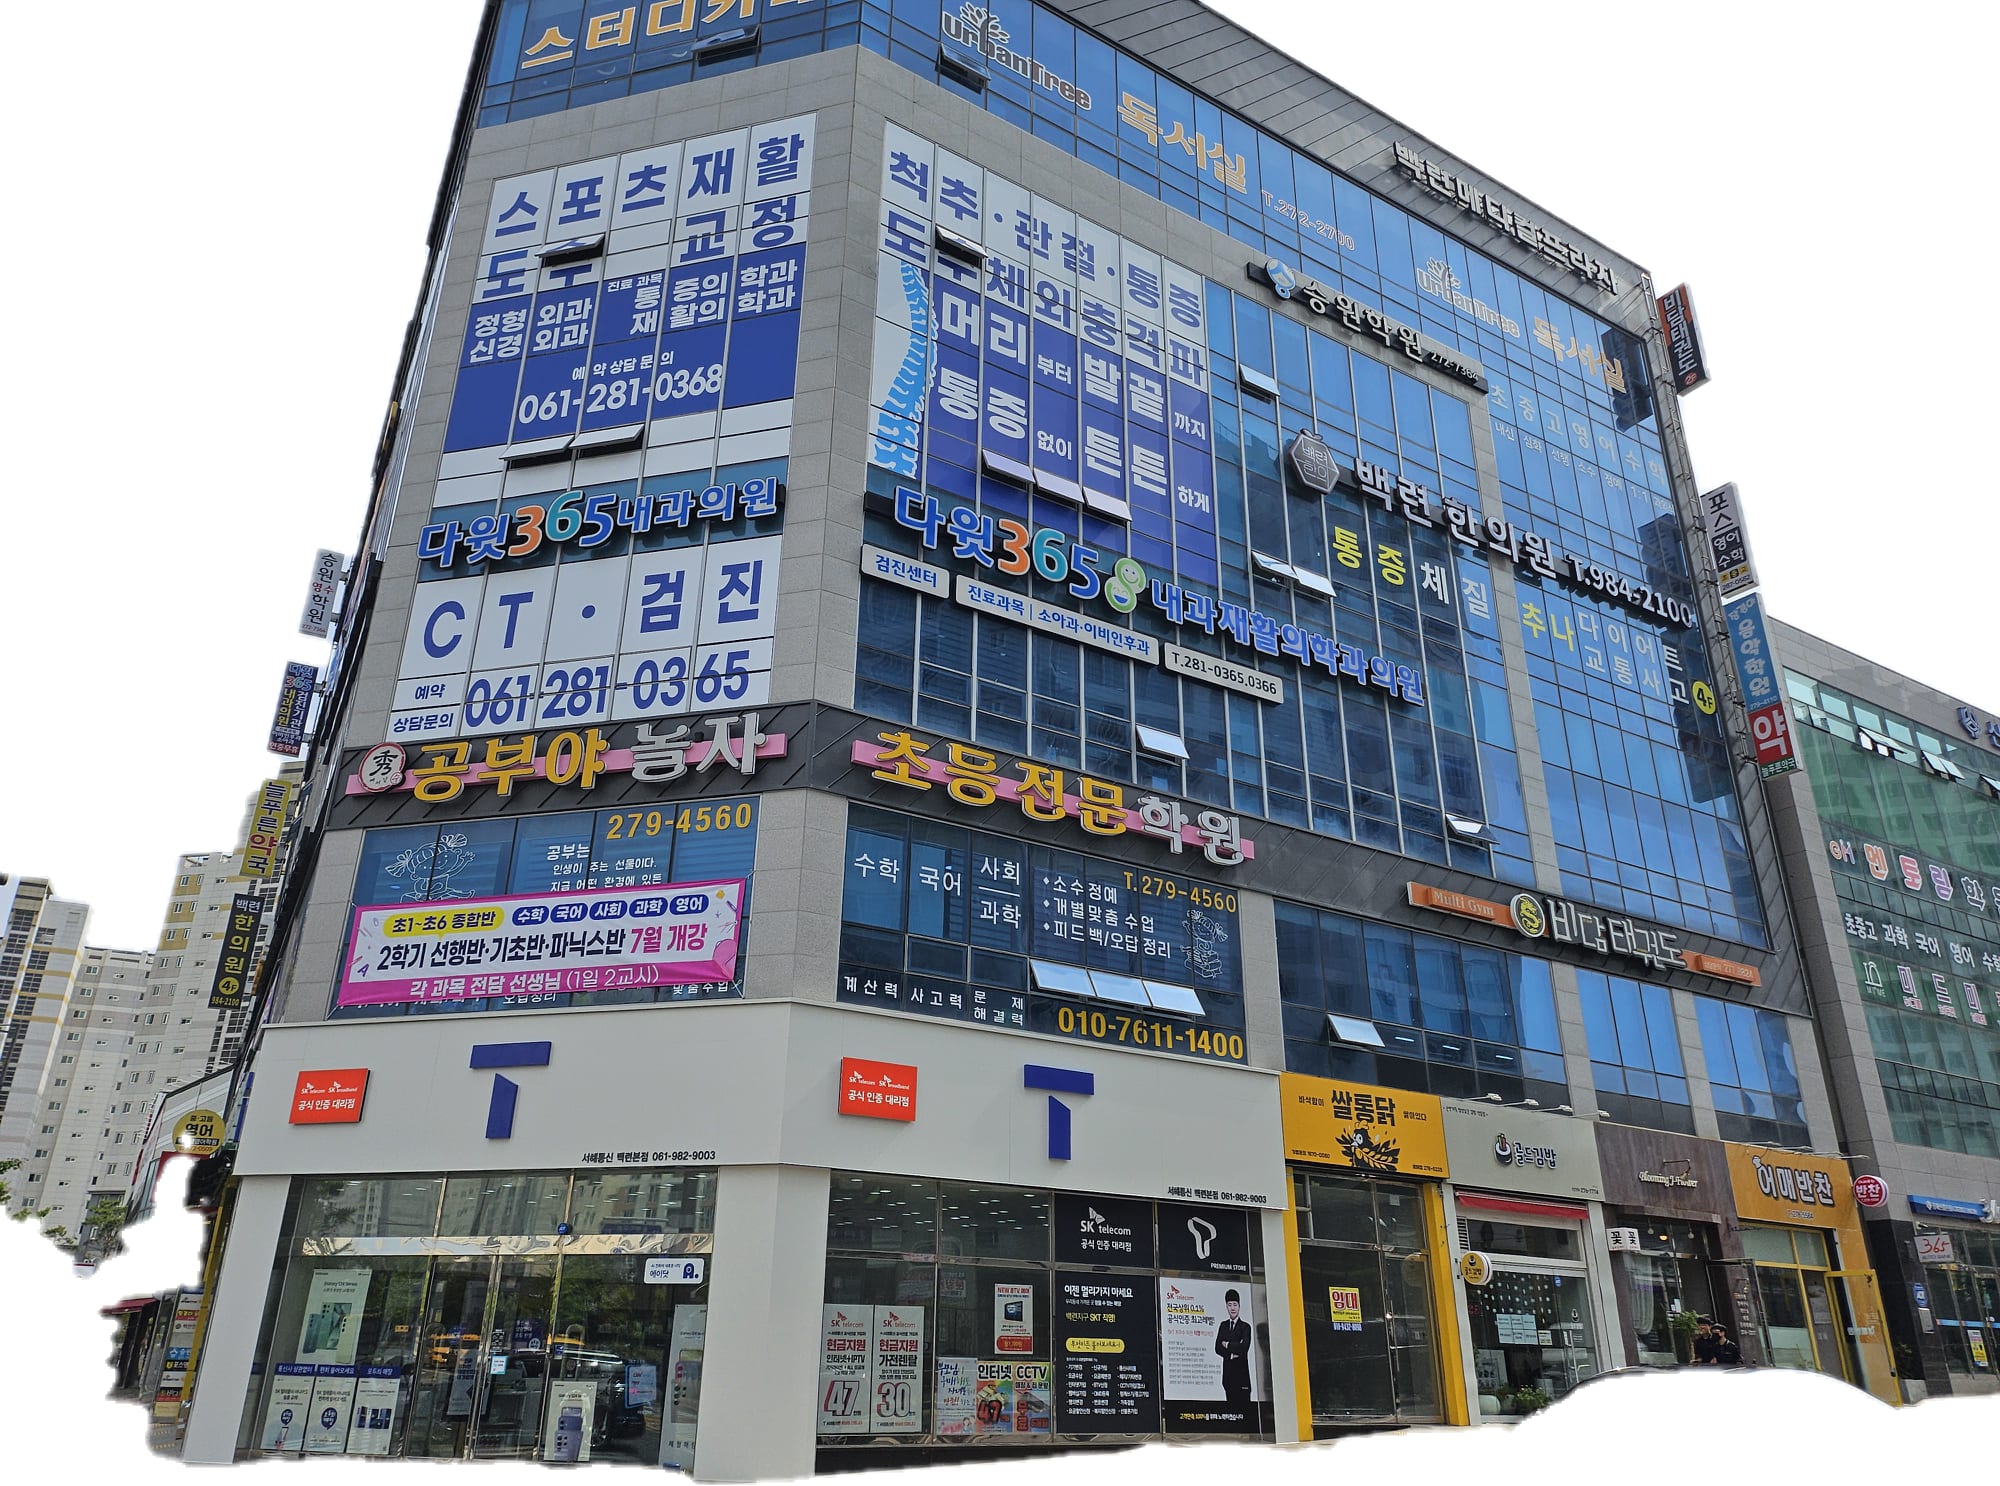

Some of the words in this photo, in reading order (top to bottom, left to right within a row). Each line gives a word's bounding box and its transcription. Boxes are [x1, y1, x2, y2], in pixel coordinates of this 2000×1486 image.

[521, 0, 816, 69] 스터디
[1117, 91, 1248, 194] 독서실
[680, 196, 797, 264] 교정
[1533, 316, 1627, 394] 독서실
[518, 363, 724, 425] 061-281-0368
[1708, 491, 1735, 533] 포스
[1713, 530, 1741, 551] 영어
[875, 553, 938, 589] 검진센터
[1718, 546, 1745, 568] 수학
[1332, 526, 1407, 587] 통증
[1420, 561, 1492, 621] 체질
[967, 583, 1025, 616] 진료과목
[1566, 553, 1694, 630] T.984-2100
[1522, 602, 1575, 652] 추나
[284, 675, 313, 692] 365
[464, 649, 750, 729] 061-281-0365
[1171, 651, 1278, 696] T.281-0365.0366
[414, 683, 446, 702] 예약
[1696, 685, 1714, 711] 4F
[392, 711, 455, 734] 상담문의
[1753, 710, 1787, 756] 약
[369, 750, 399, 776] 秀
[412, 728, 609, 803] 공부야
[629, 712, 768, 784] 놀자
[247, 781, 287, 874] 늘푸른약국
[606, 802, 753, 840] 279-4560
[1137, 795, 1245, 867] 학원
[546, 844, 590, 861] 공부는
[853, 852, 900, 884] 수학
[919, 865, 962, 896] 국어
[979, 856, 1021, 885] 사회
[1052, 875, 1118, 905] 소수정예
[1123, 871, 1238, 914] T.279-4560
[1433, 890, 1466, 910] Multi
[1468, 899, 1496, 917] Gym
[392, 914, 448, 934] 초1~초6
[451, 910, 497, 930] 종합반
[516, 905, 545, 924] 수학
[555, 904, 584, 921] 국어
[594, 901, 623, 918] 사회
[633, 897, 663, 916] 과학
[674, 895, 704, 913] 영어
[979, 899, 1022, 930] 과학
[224, 913, 255, 975] 한의원
[376, 940, 427, 972] 2학기
[629, 926, 662, 955] 7월
[665, 922, 708, 952] 개강
[1881, 923, 1910, 950] 과학
[1914, 931, 1942, 958] 국어
[1949, 942, 1976, 968] 영어
[410, 980, 429, 998] 각
[431, 977, 467, 996] 과목
[470, 975, 507, 994] 전담
[509, 971, 561, 991] 선생님
[603, 964, 660, 987] 2교시)
[843, 974, 900, 1000] 계산력
[910, 988, 963, 1010] 사고력
[1057, 1006, 1244, 1060] 010-7611-1400
[298, 1100, 315, 1111] 공식
[315, 1099, 331, 1110] 인증
[332, 1098, 356, 1110] 대리점
[848, 1089, 865, 1102] 공식
[866, 1092, 884, 1104] 인증
[885, 1094, 910, 1108] 대리점
[1331, 1089, 1396, 1127] 쌀통닭
[185, 1123, 214, 1137] 영어
[652, 1150, 716, 1162] 061-982-9003
[1856, 1184, 1881, 1199] 반찬
[1080, 1220, 1095, 1233] SK
[1098, 1224, 1131, 1236] telecom
[1610, 1231, 1623, 1245] 꽃
[1080, 1239, 1095, 1251] 공식
[1096, 1240, 1111, 1251] 인증
[1111, 1241, 1132, 1252] 대리점
[1919, 1237, 1951, 1254] 365
[1064, 1284, 1080, 1298] 이젠
[1081, 1285, 1111, 1298] 멀리가지
[1111, 1287, 1134, 1298] 마세요
[1332, 1291, 1359, 1310] 임대
[830, 1319, 841, 1327] SK
[882, 1319, 893, 1327] SK
[1089, 1313, 1102, 1322] SKT
[826, 1338, 867, 1352] 현금지원
[878, 1354, 918, 1368] 가전렌탈
[879, 1339, 919, 1352] 현금지원
[977, 1363, 1012, 1380] 인터넷
[1016, 1365, 1048, 1380] CCTV
[823, 1380, 860, 1417] 47
[876, 1381, 912, 1418] 30
